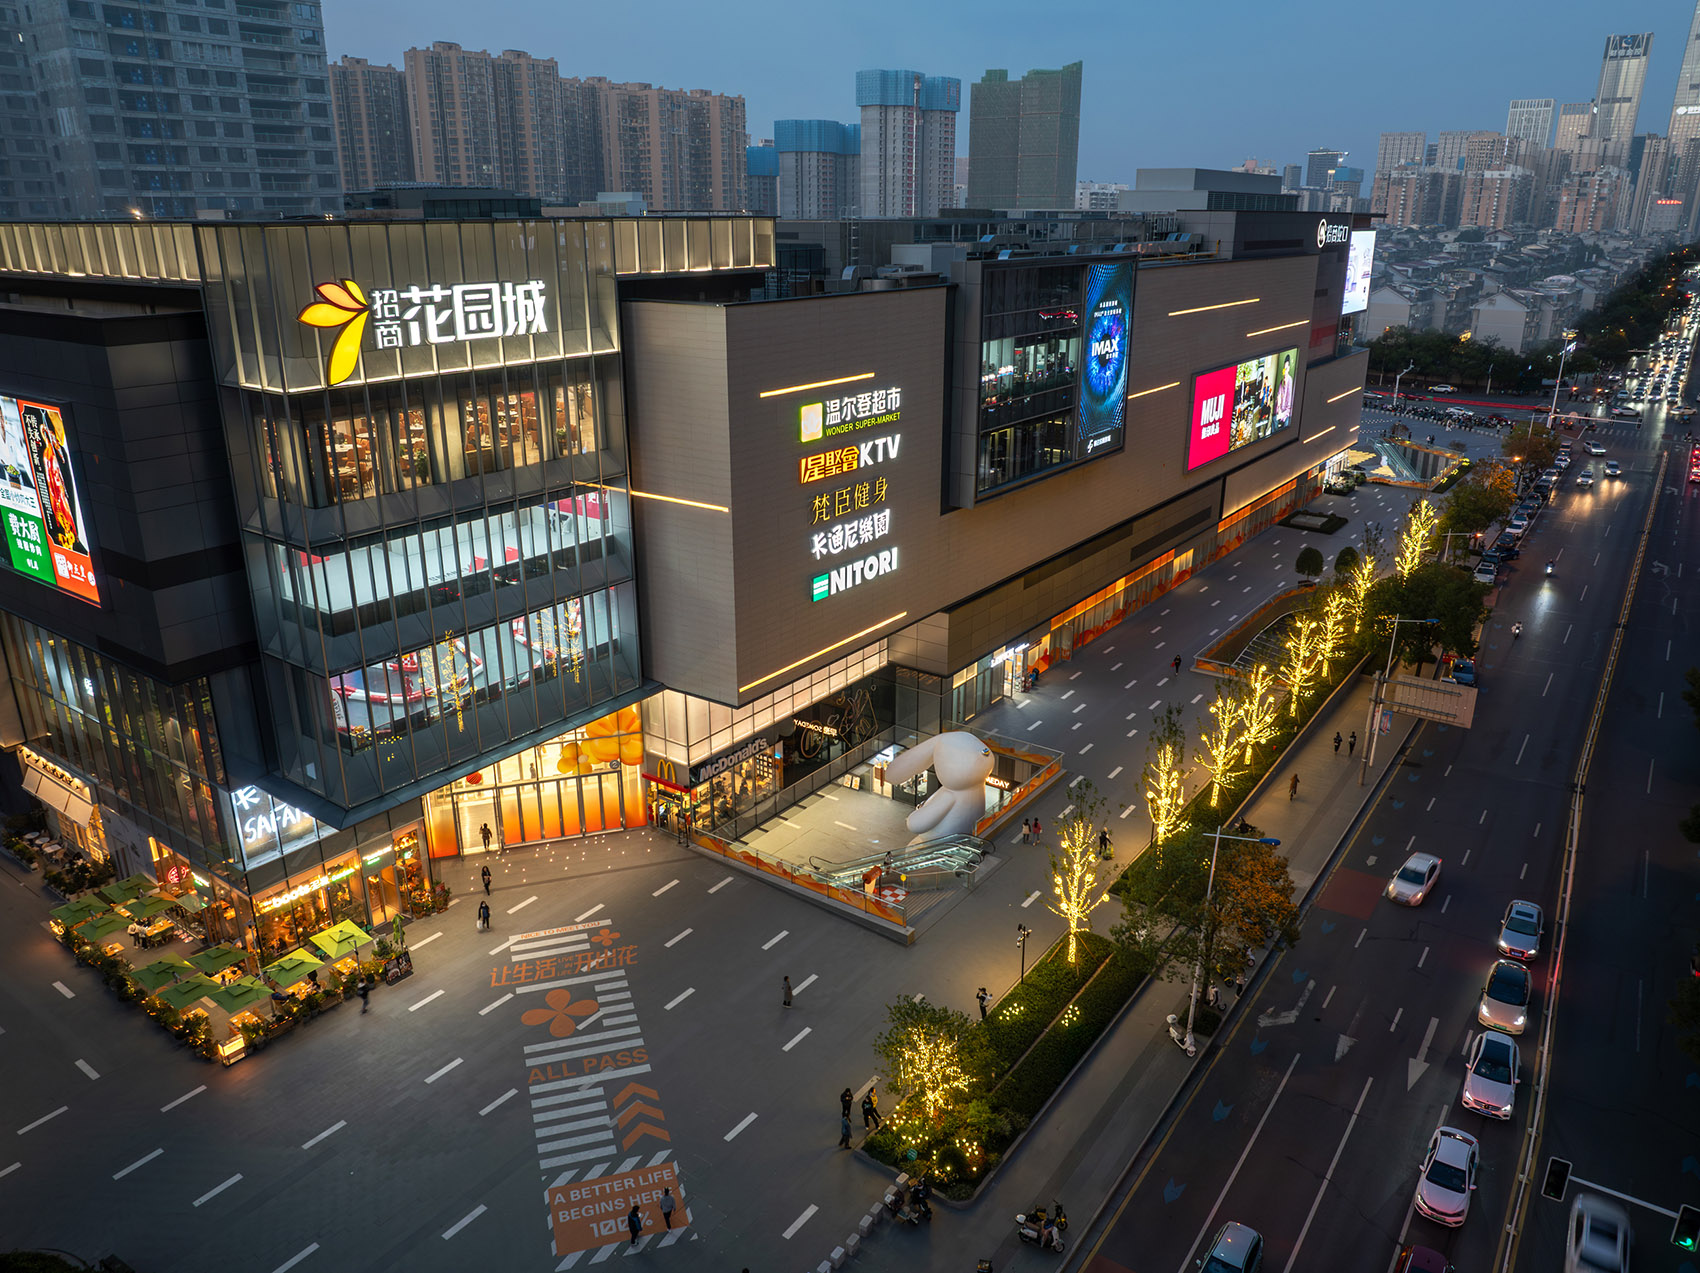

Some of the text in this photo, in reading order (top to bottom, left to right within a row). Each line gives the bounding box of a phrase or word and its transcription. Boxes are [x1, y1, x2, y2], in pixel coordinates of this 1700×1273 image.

[371, 289, 403, 350] 招商
[400, 279, 548, 345] 花园城
[1091, 335, 1120, 357] IMAX
[825, 387, 901, 425] 温尔登超市
[825, 412, 901, 437] WONDER SUPER-MARKET
[1200, 394, 1225, 426] MUJI
[860, 434, 901, 468] KTV
[810, 477, 888, 525] 梵臣健身
[830, 547, 898, 595] NITORI
[700, 737, 768, 782] McDonald's
[581, 921, 601, 929] YOU
[490, 944, 638, 988] 让生活 开出花
[528, 1048, 649, 1084] ALL PASS
[554, 1169, 673, 1206] A BETTER LIFE
[558, 1198, 626, 1223] BEGINS
